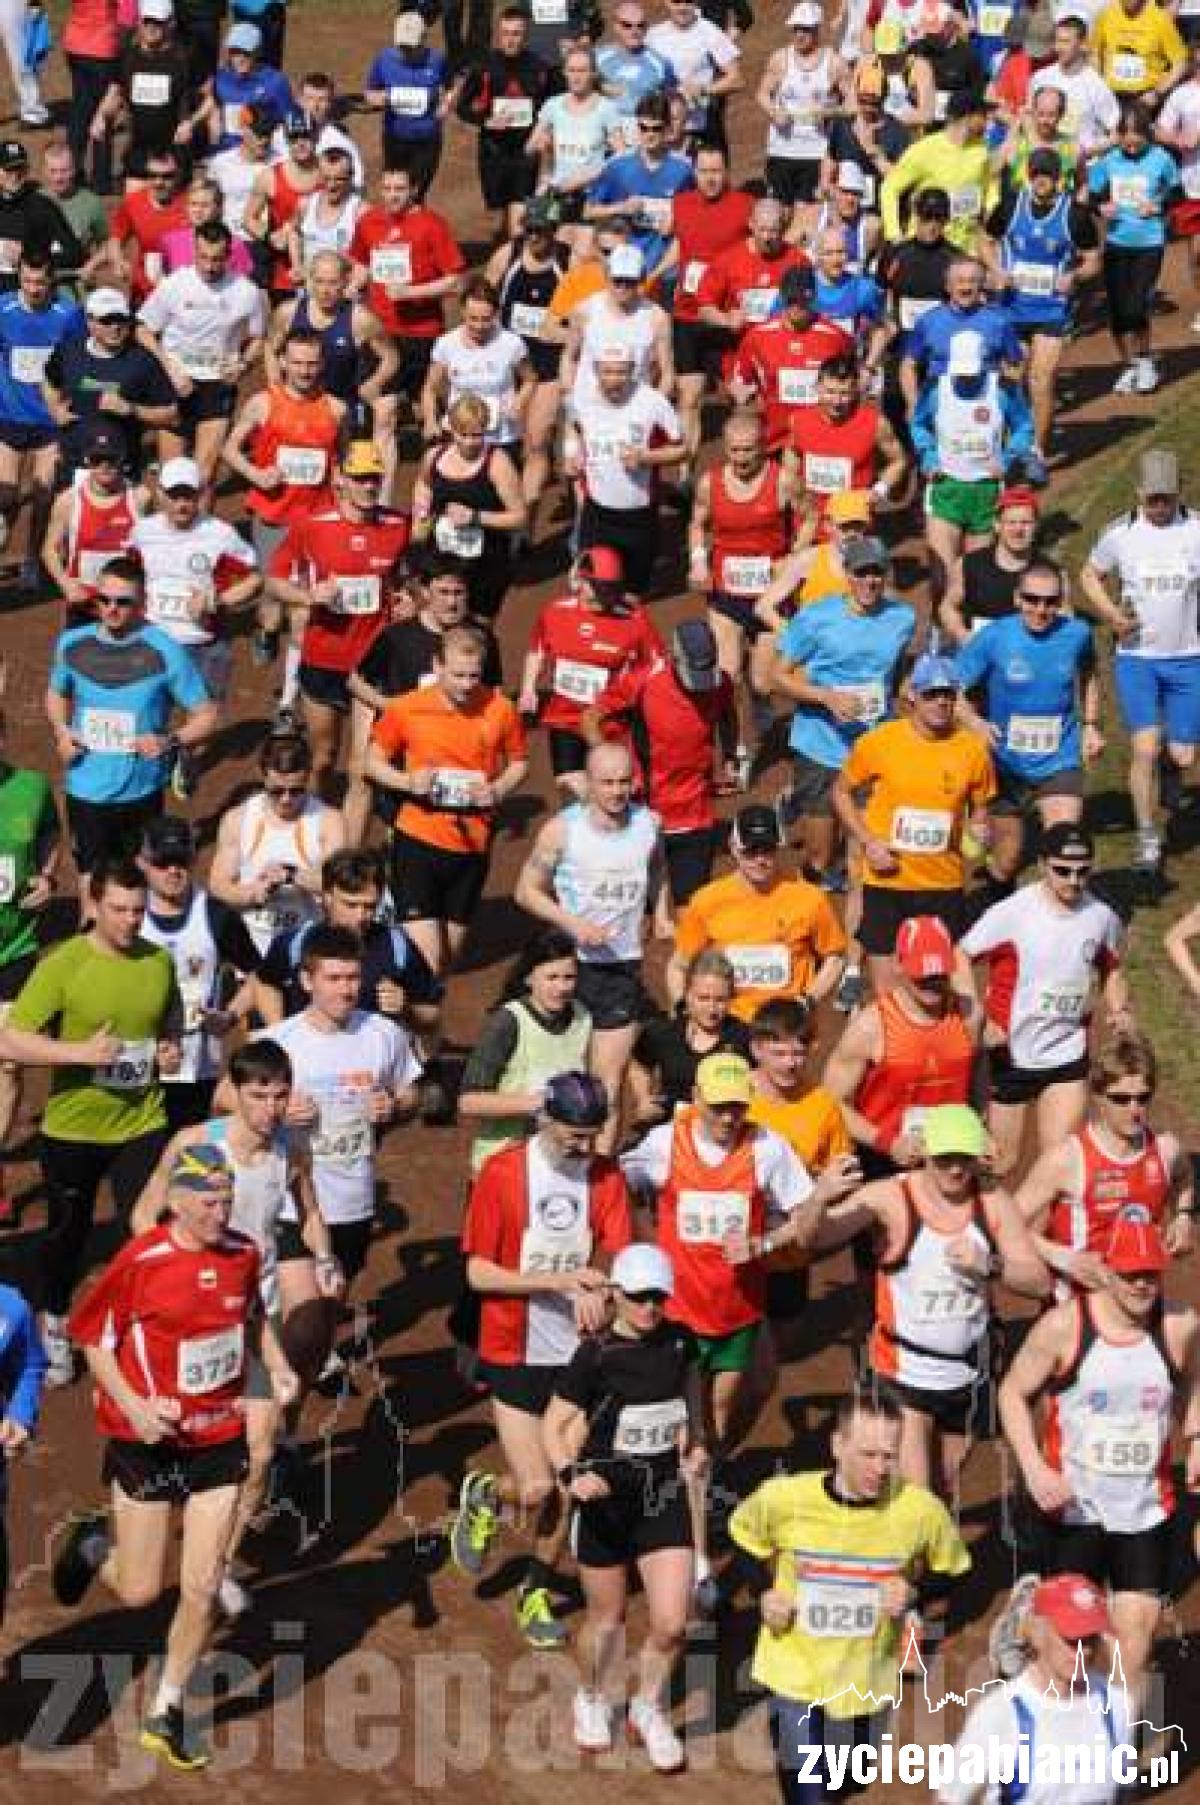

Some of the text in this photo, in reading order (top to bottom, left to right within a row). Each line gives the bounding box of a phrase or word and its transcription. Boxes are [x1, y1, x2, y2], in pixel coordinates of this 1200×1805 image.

[684, 1213, 745, 1236] 312
[921, 1289, 980, 1315] 777
[1090, 1441, 1151, 1467] 158
[807, 1603, 874, 1632] 026
